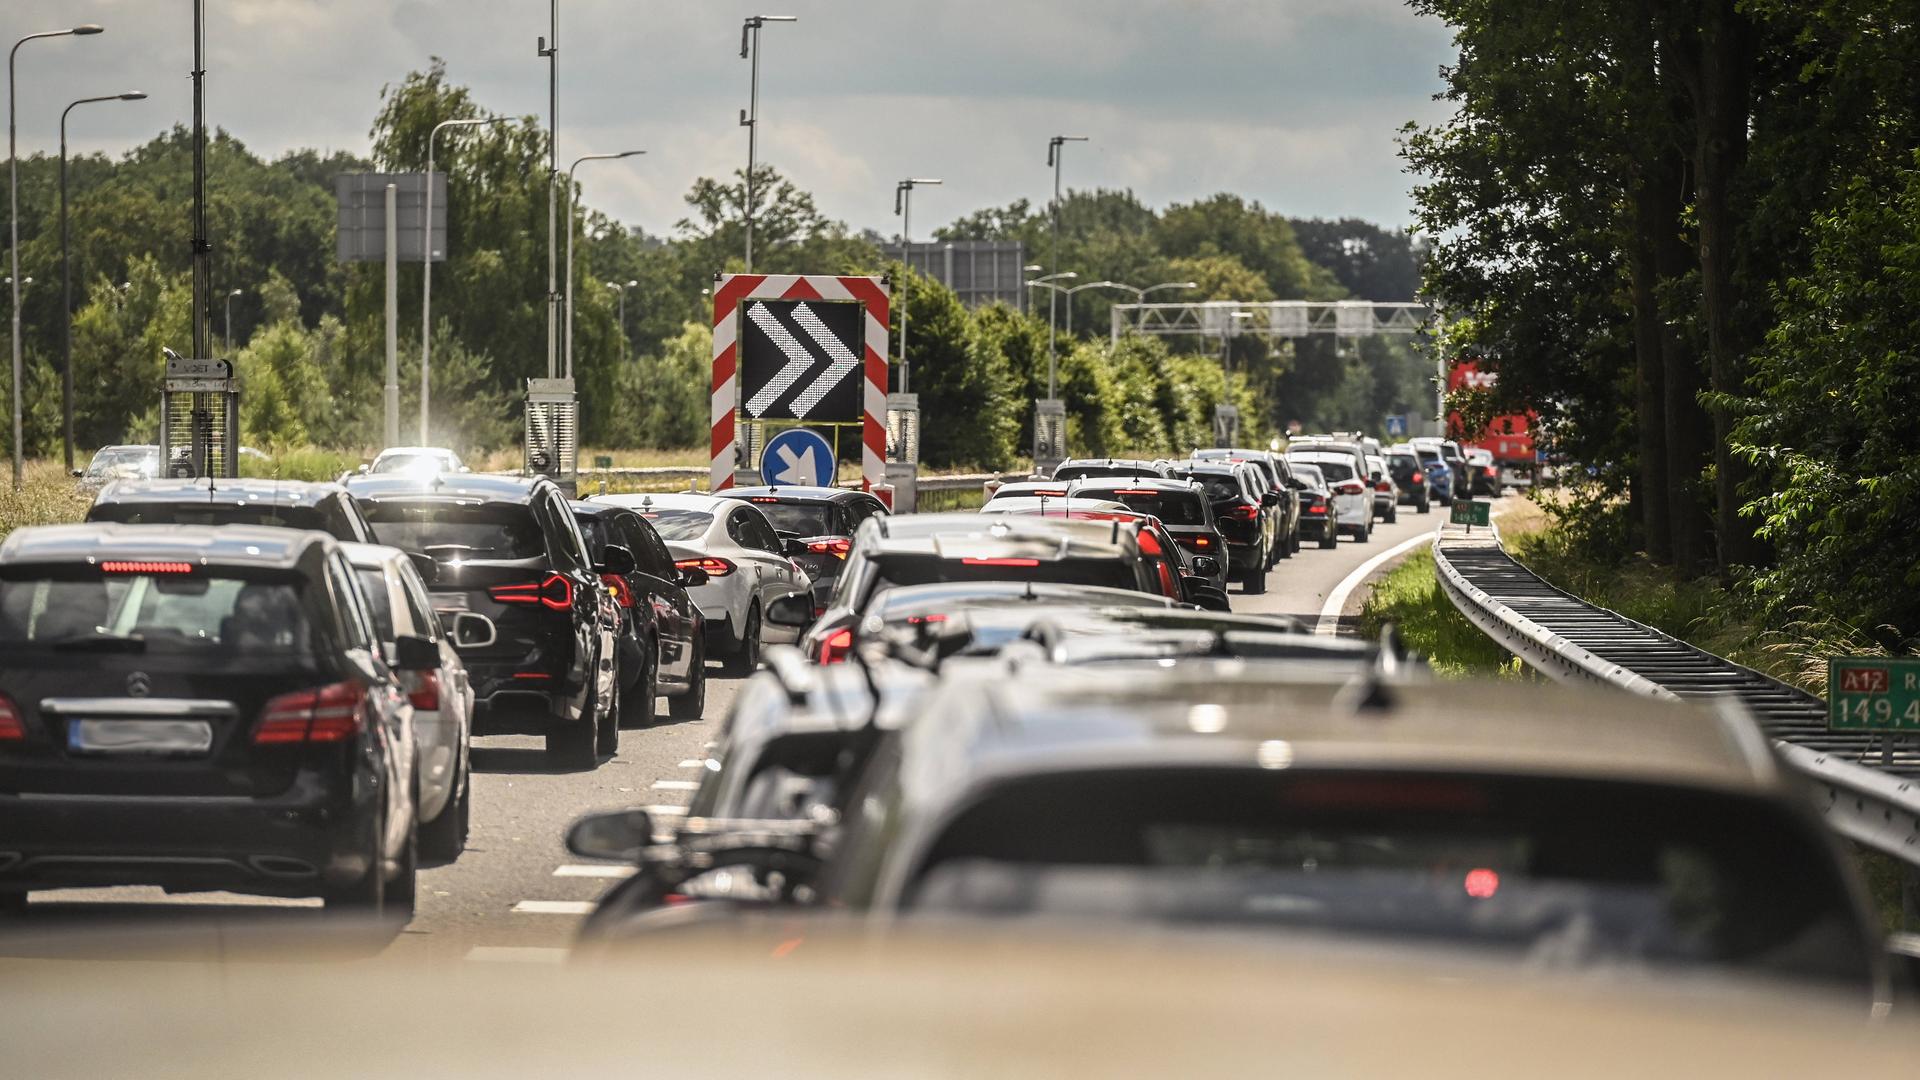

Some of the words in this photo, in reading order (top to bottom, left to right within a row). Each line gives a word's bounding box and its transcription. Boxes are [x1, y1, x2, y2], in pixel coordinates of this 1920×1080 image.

[1844, 671, 1884, 689] A12
[1904, 672, 1920, 690] R
[1839, 698, 1920, 727] 149,4
